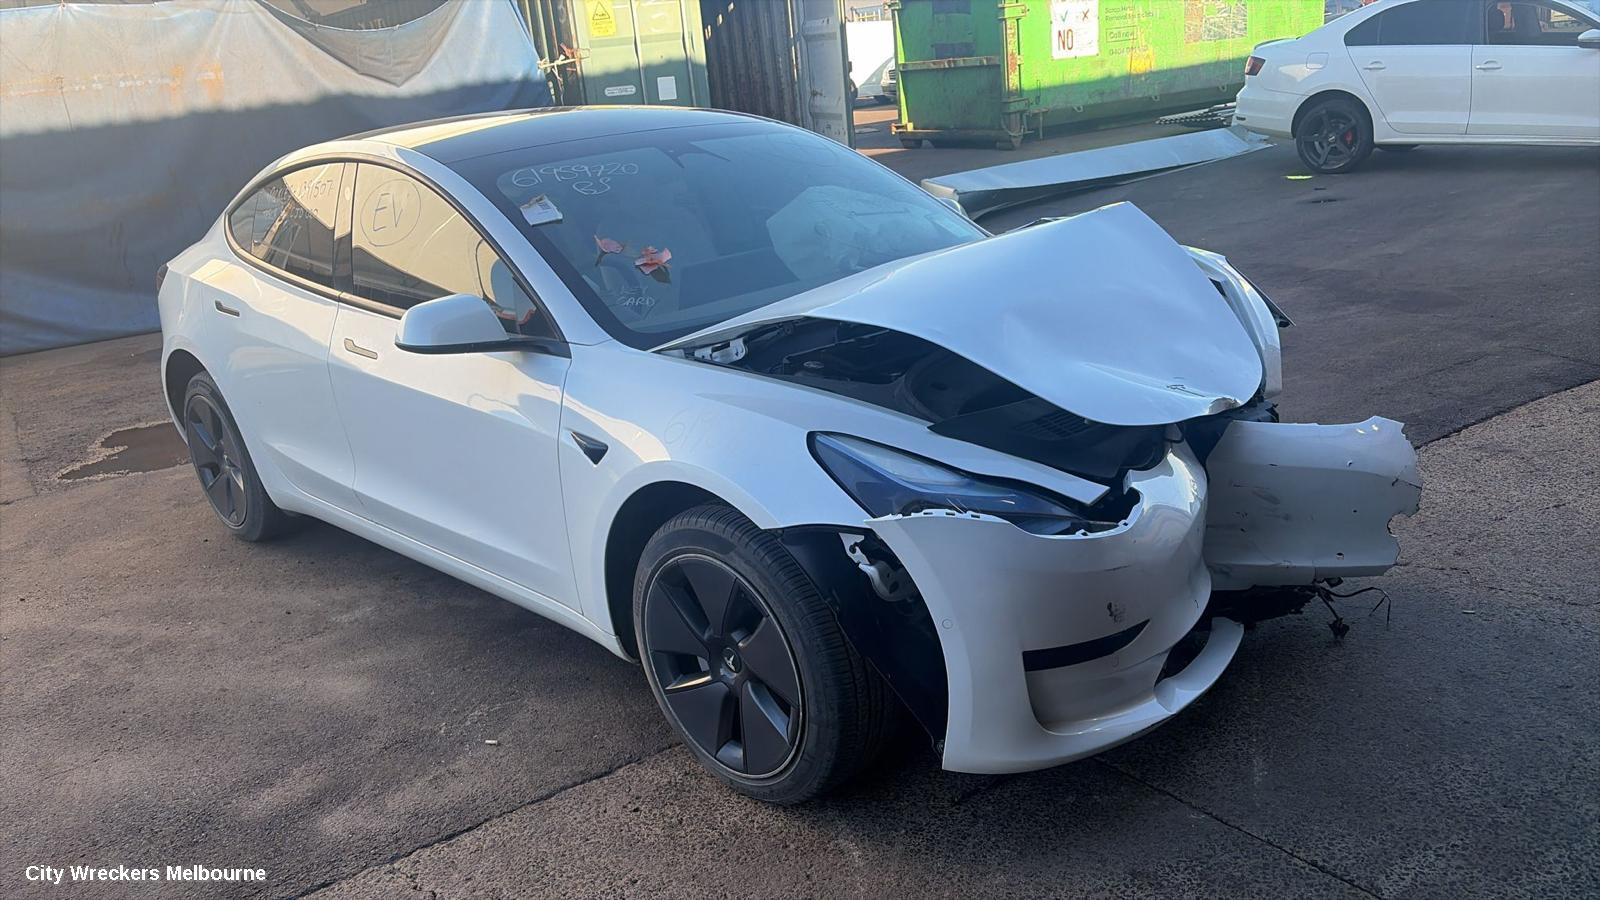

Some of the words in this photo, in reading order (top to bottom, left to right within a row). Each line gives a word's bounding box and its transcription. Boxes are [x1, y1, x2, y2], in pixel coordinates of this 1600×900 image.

[1057, 28, 1073, 51] NO
[1109, 31, 1121, 39] Call
[372, 192, 409, 232] EV
[616, 295, 656, 307] CARD
